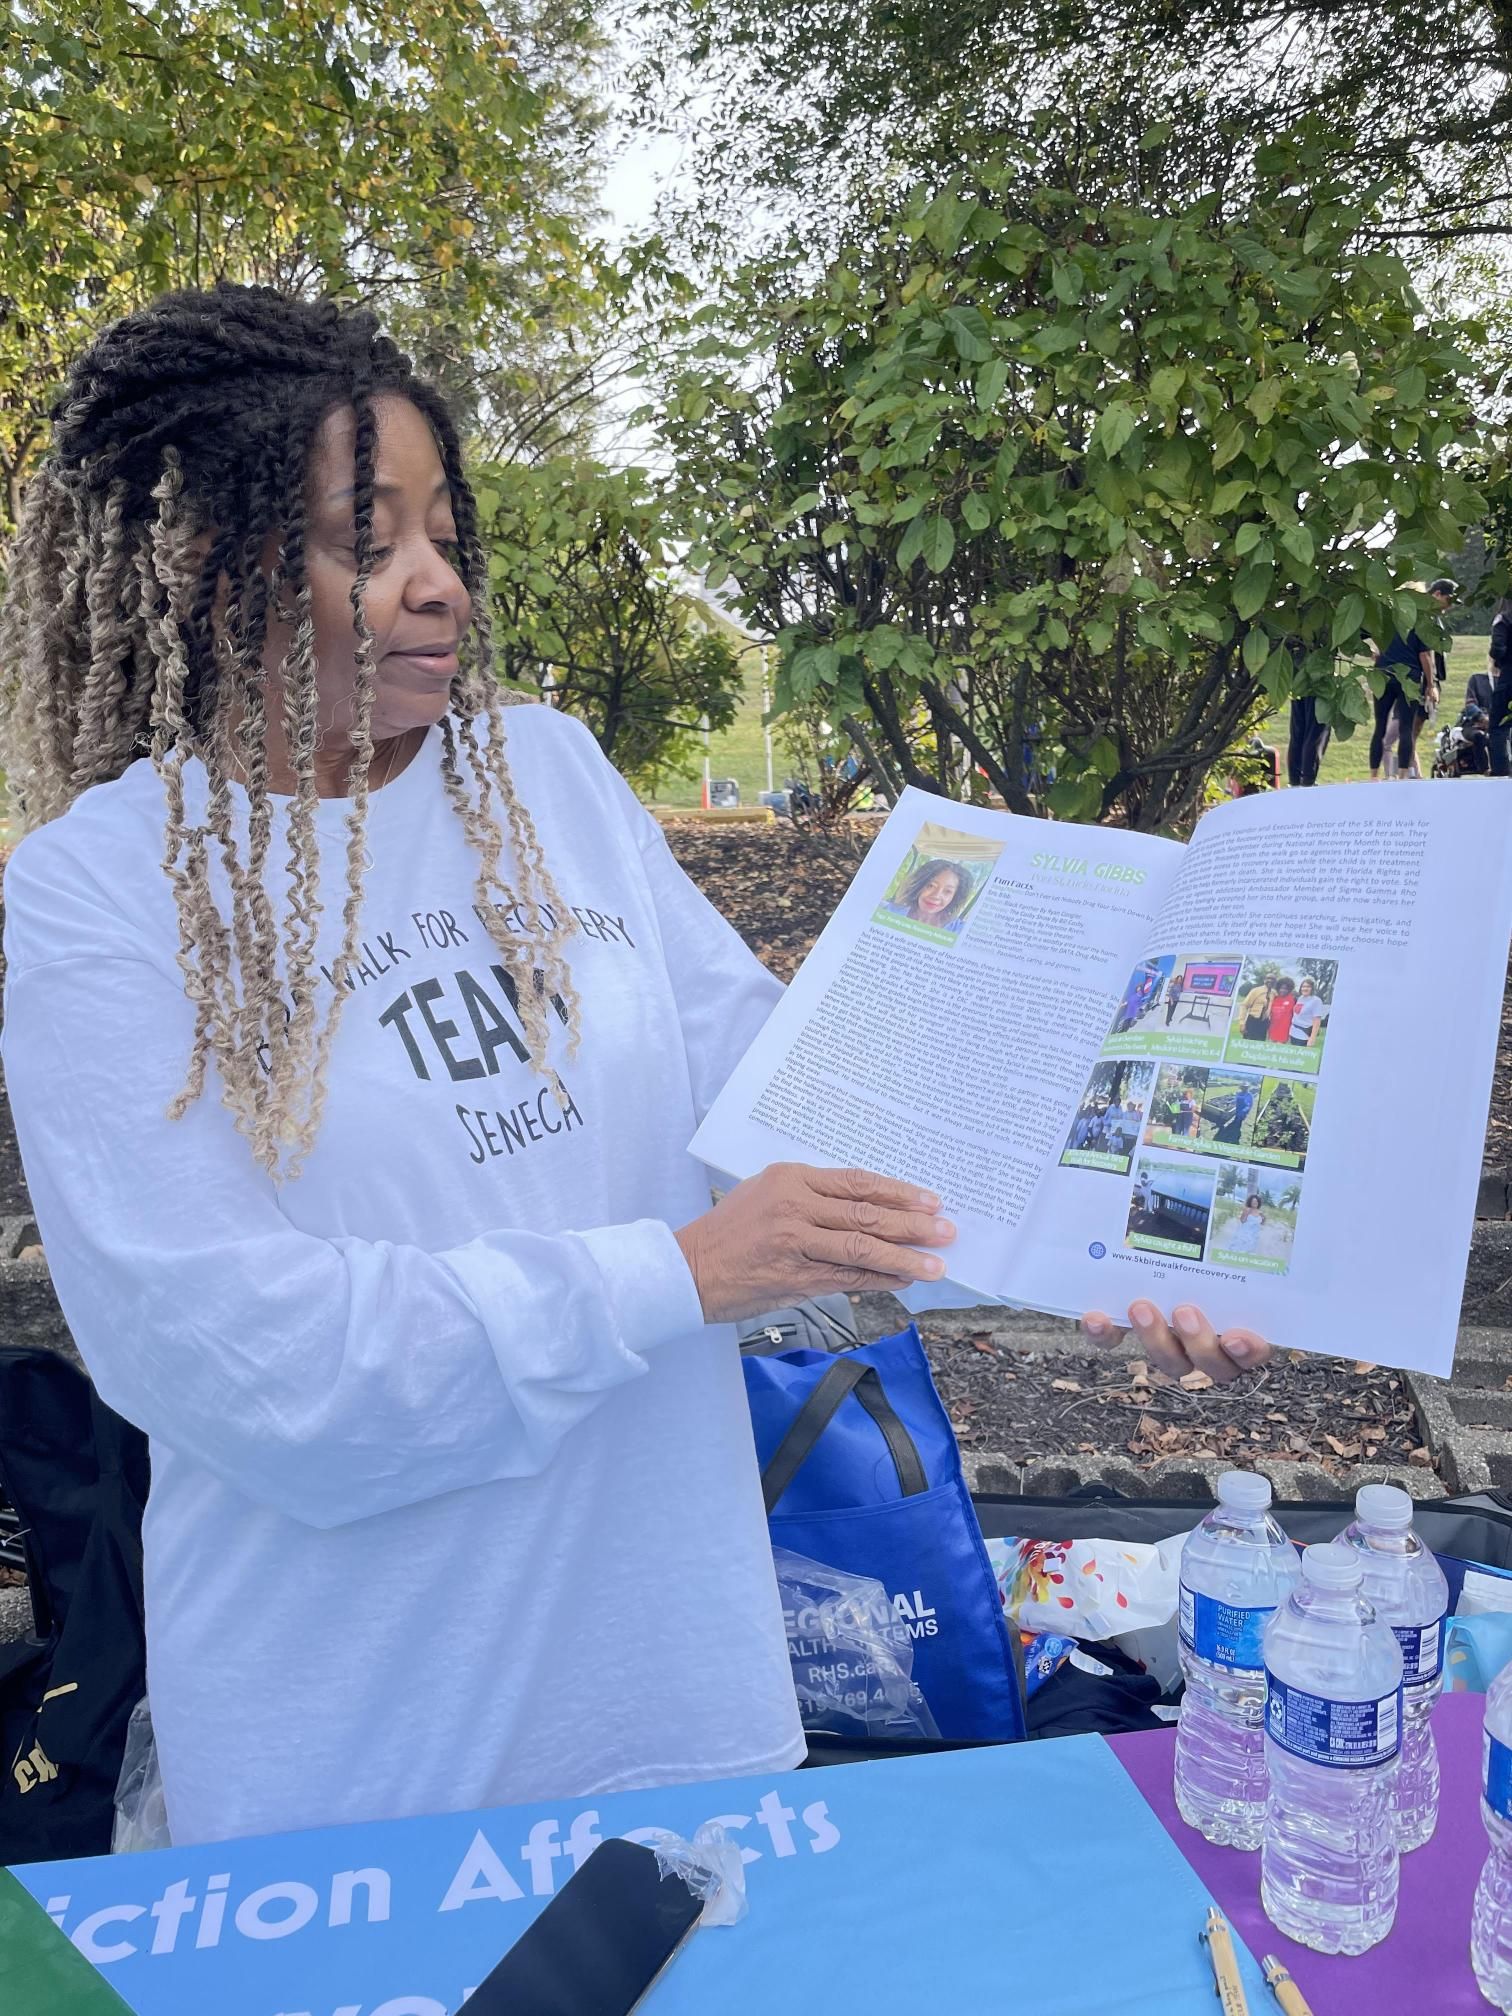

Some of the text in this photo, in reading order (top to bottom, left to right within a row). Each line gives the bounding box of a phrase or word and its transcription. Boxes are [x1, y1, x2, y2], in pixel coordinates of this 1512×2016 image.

[1031, 852, 1147, 885] SYLVIA GIBBS
[412, 910, 469, 949] FOR
[456, 1071, 583, 1164] SENECA
[1112, 1251, 1246, 1283] www.5kbirdwalkforrecovery.org
[1218, 1605, 1250, 1619] PURIFIED
[1218, 1613, 1243, 1626] WATER
[788, 1636, 837, 1657] ALTH
[808, 1661, 877, 1684] RHS.ca
[437, 1790, 841, 1912] Affcts
